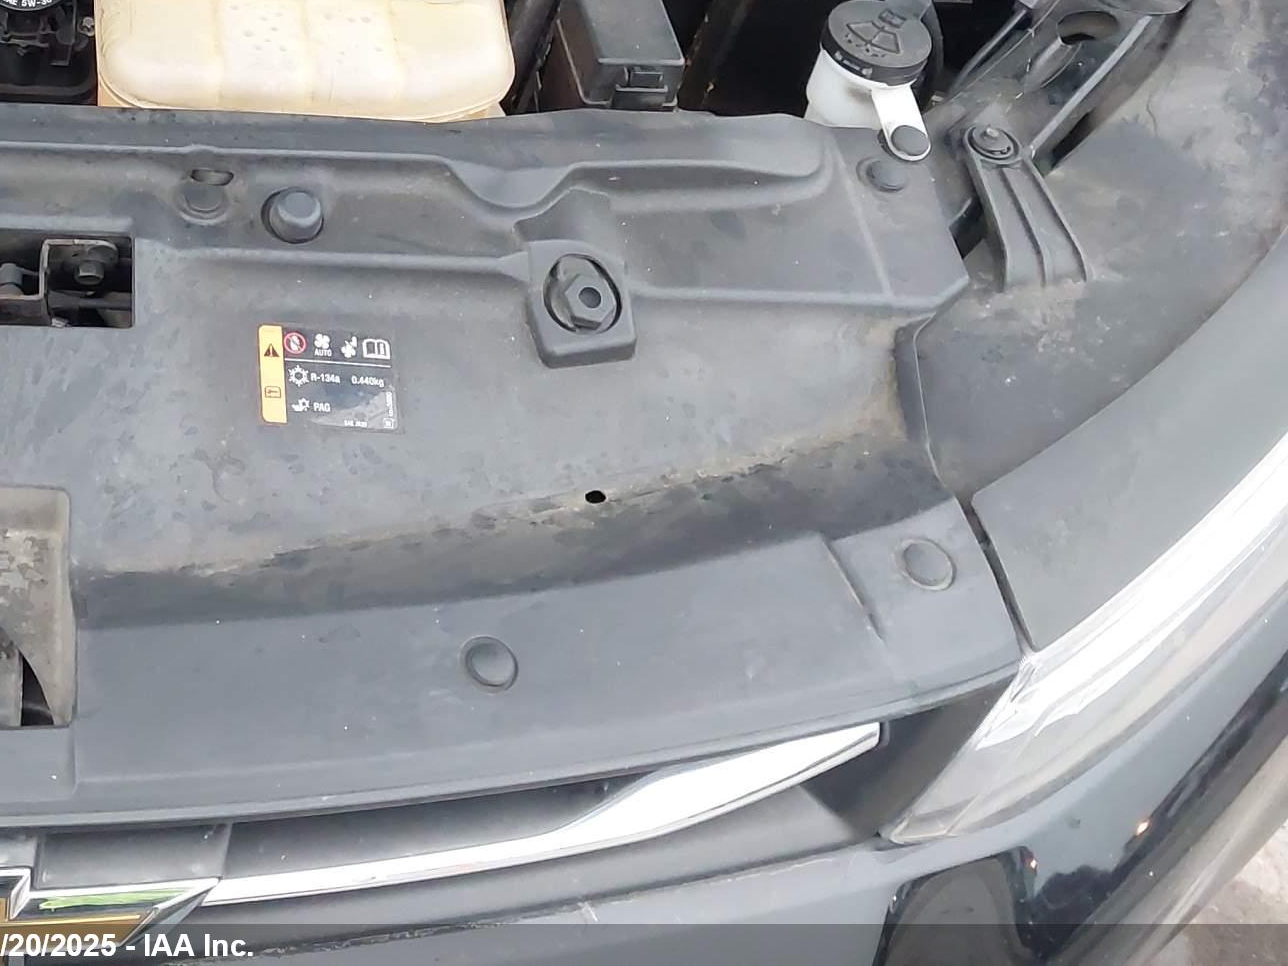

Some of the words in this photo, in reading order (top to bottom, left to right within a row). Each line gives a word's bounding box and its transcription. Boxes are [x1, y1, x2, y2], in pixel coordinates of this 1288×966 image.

[314, 349, 332, 357] AUTO
[310, 373, 341, 384] R-134a
[351, 375, 385, 388] 0.440kg
